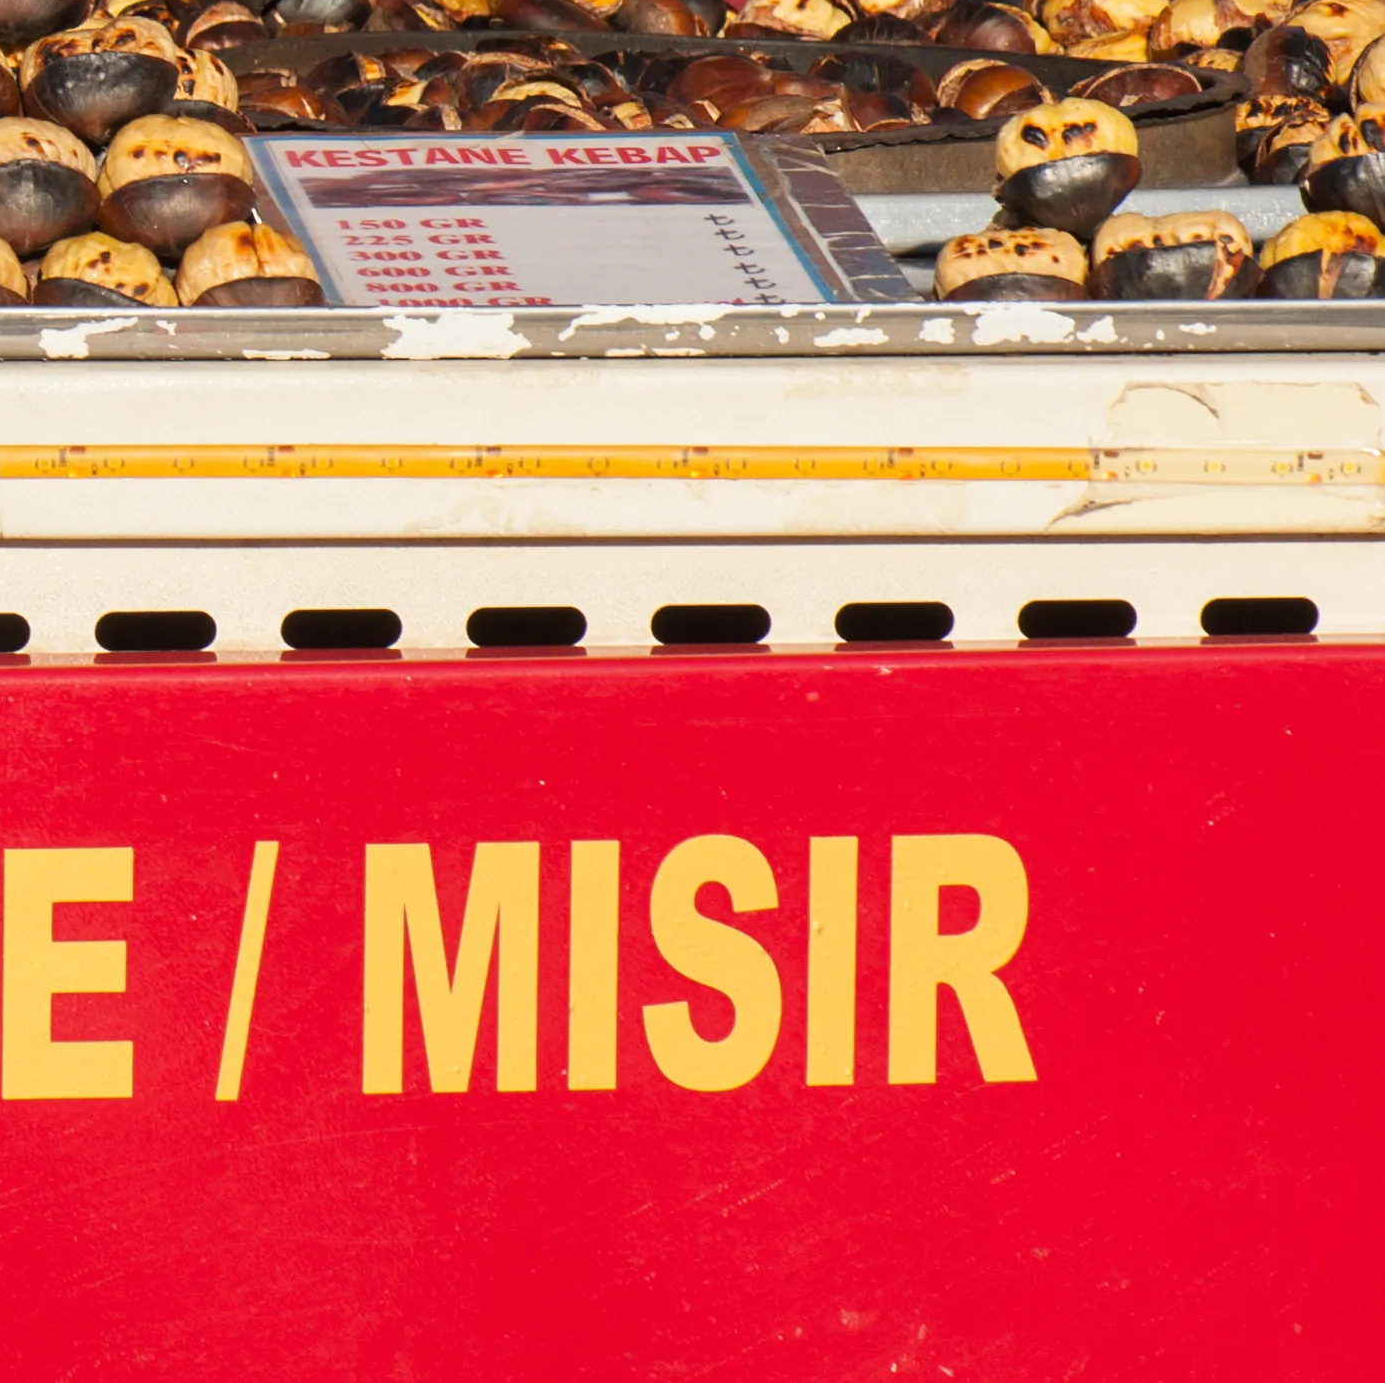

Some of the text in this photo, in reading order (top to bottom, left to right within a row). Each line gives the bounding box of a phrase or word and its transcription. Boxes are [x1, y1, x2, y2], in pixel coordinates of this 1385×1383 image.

[285, 146, 722, 168] KESTANE KEBAP
[337, 219, 407, 230] 150
[420, 218, 487, 230] GR
[340, 235, 414, 246] 225
[428, 234, 496, 245] GR
[349, 250, 423, 262] 300
[436, 249, 505, 261] GR
[357, 267, 431, 278] 600
[444, 265, 514, 277] GR
[366, 282, 440, 294] 800
[453, 281, 523, 292] GR
[215, 840, 281, 1103] /
[361, 833, 1038, 1097] MISIR
